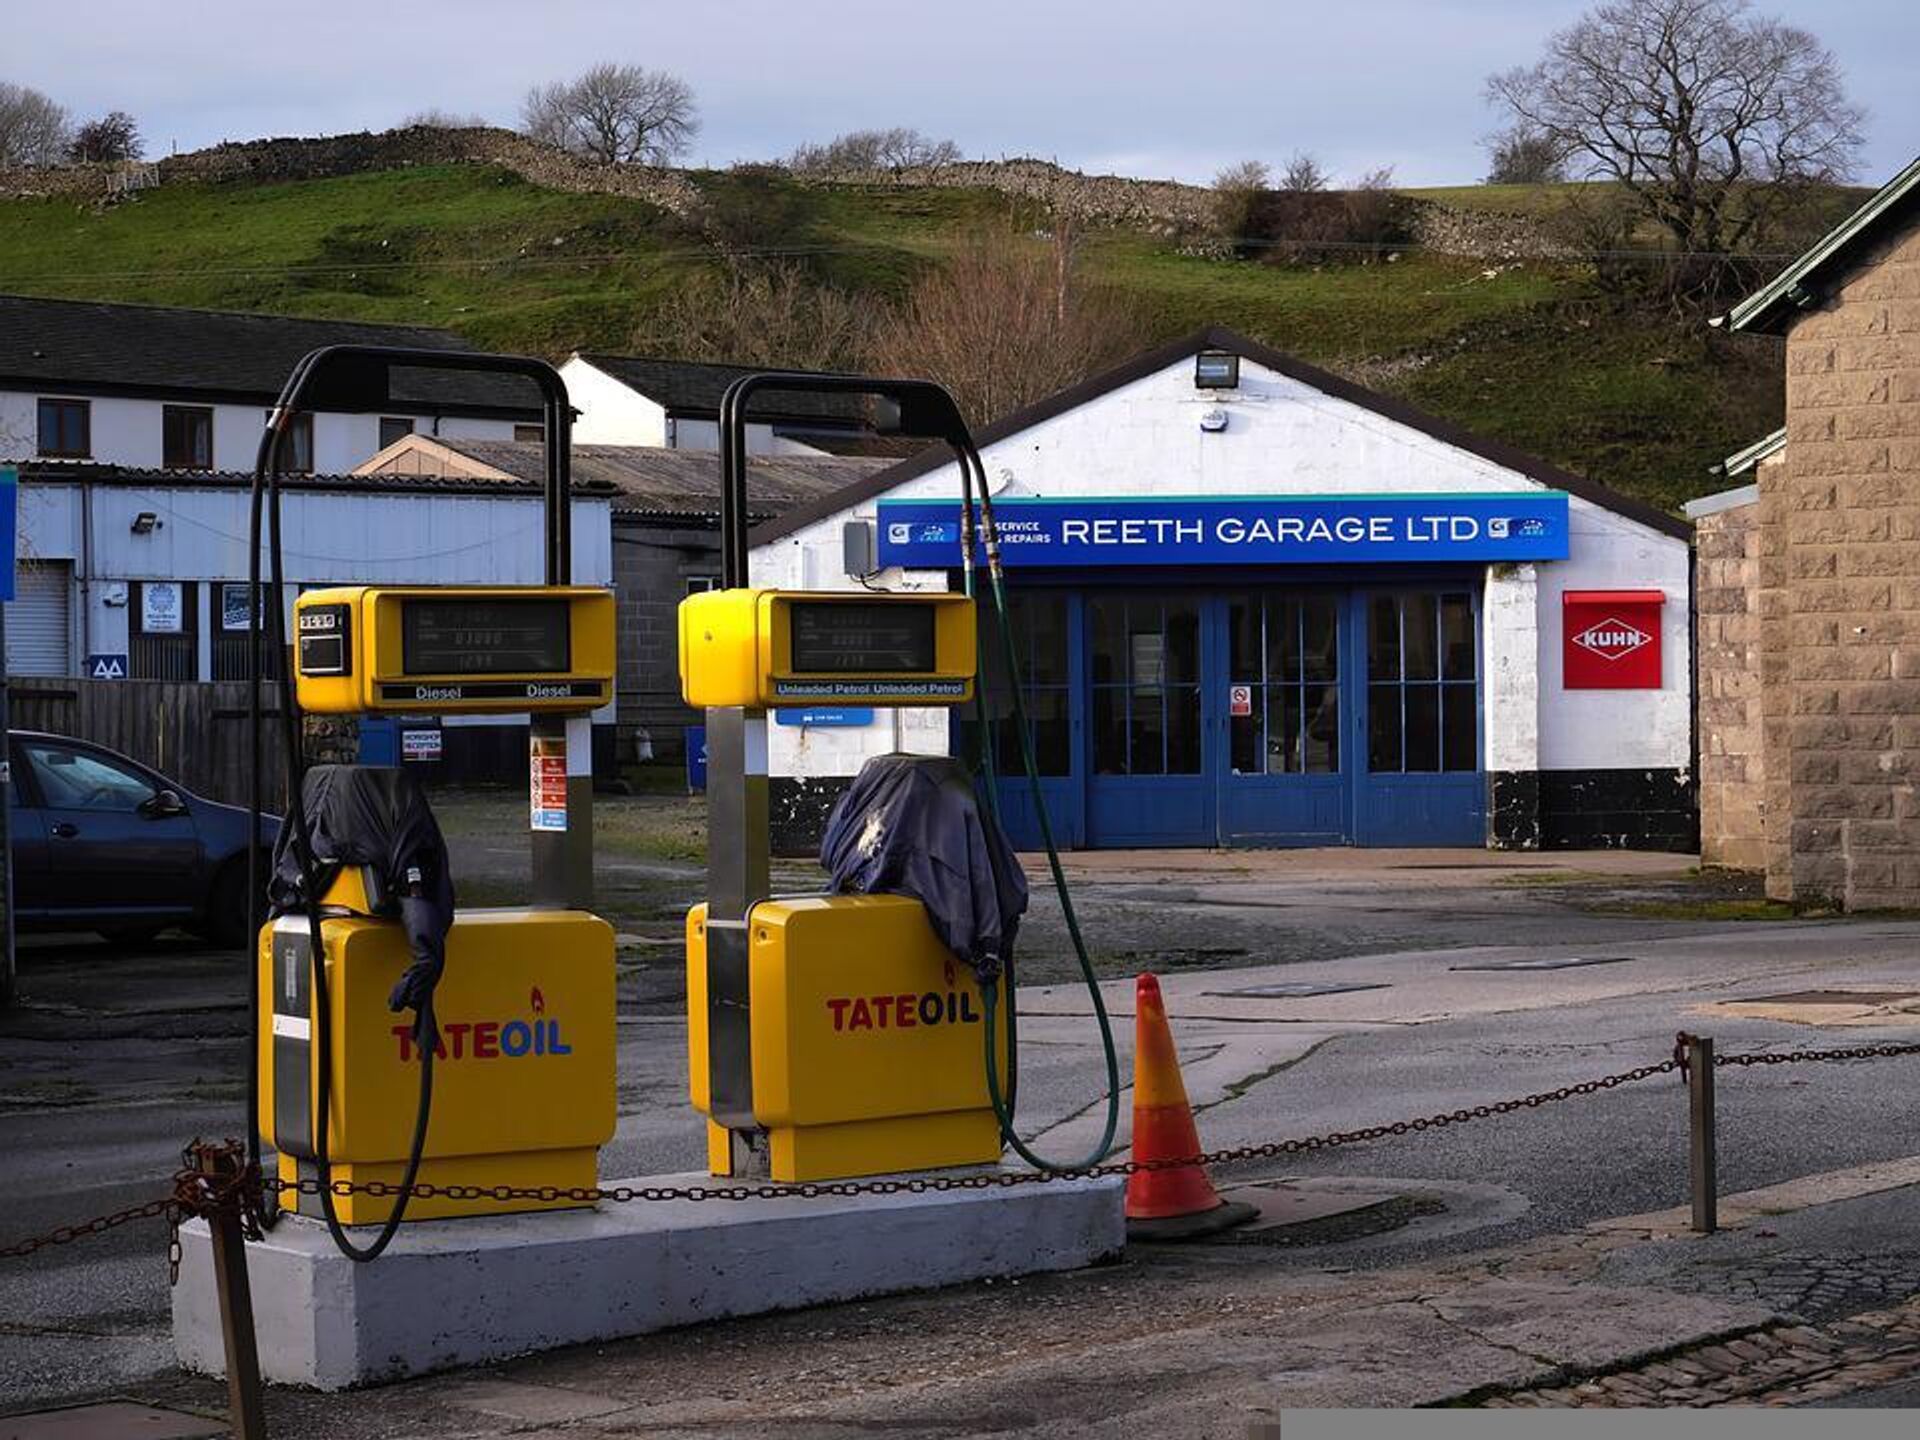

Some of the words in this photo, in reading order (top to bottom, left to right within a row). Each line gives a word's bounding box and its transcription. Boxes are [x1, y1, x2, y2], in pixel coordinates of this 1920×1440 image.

[994, 522, 1040, 531] SERVICE
[1062, 519, 1203, 544] REETH
[1216, 517, 1395, 544] GARAGE
[1407, 516, 1479, 542] LTD
[1004, 534, 1051, 543] REPAIRS
[1584, 630, 1640, 647] KUHN
[416, 687, 462, 699] Diesel
[526, 684, 571, 697] Diesel
[777, 684, 833, 695] Unleaded
[835, 684, 870, 695] Petrol
[873, 684, 927, 695] Unleaded
[929, 683, 963, 694] Petrol
[827, 991, 980, 1031] TATEOIL
